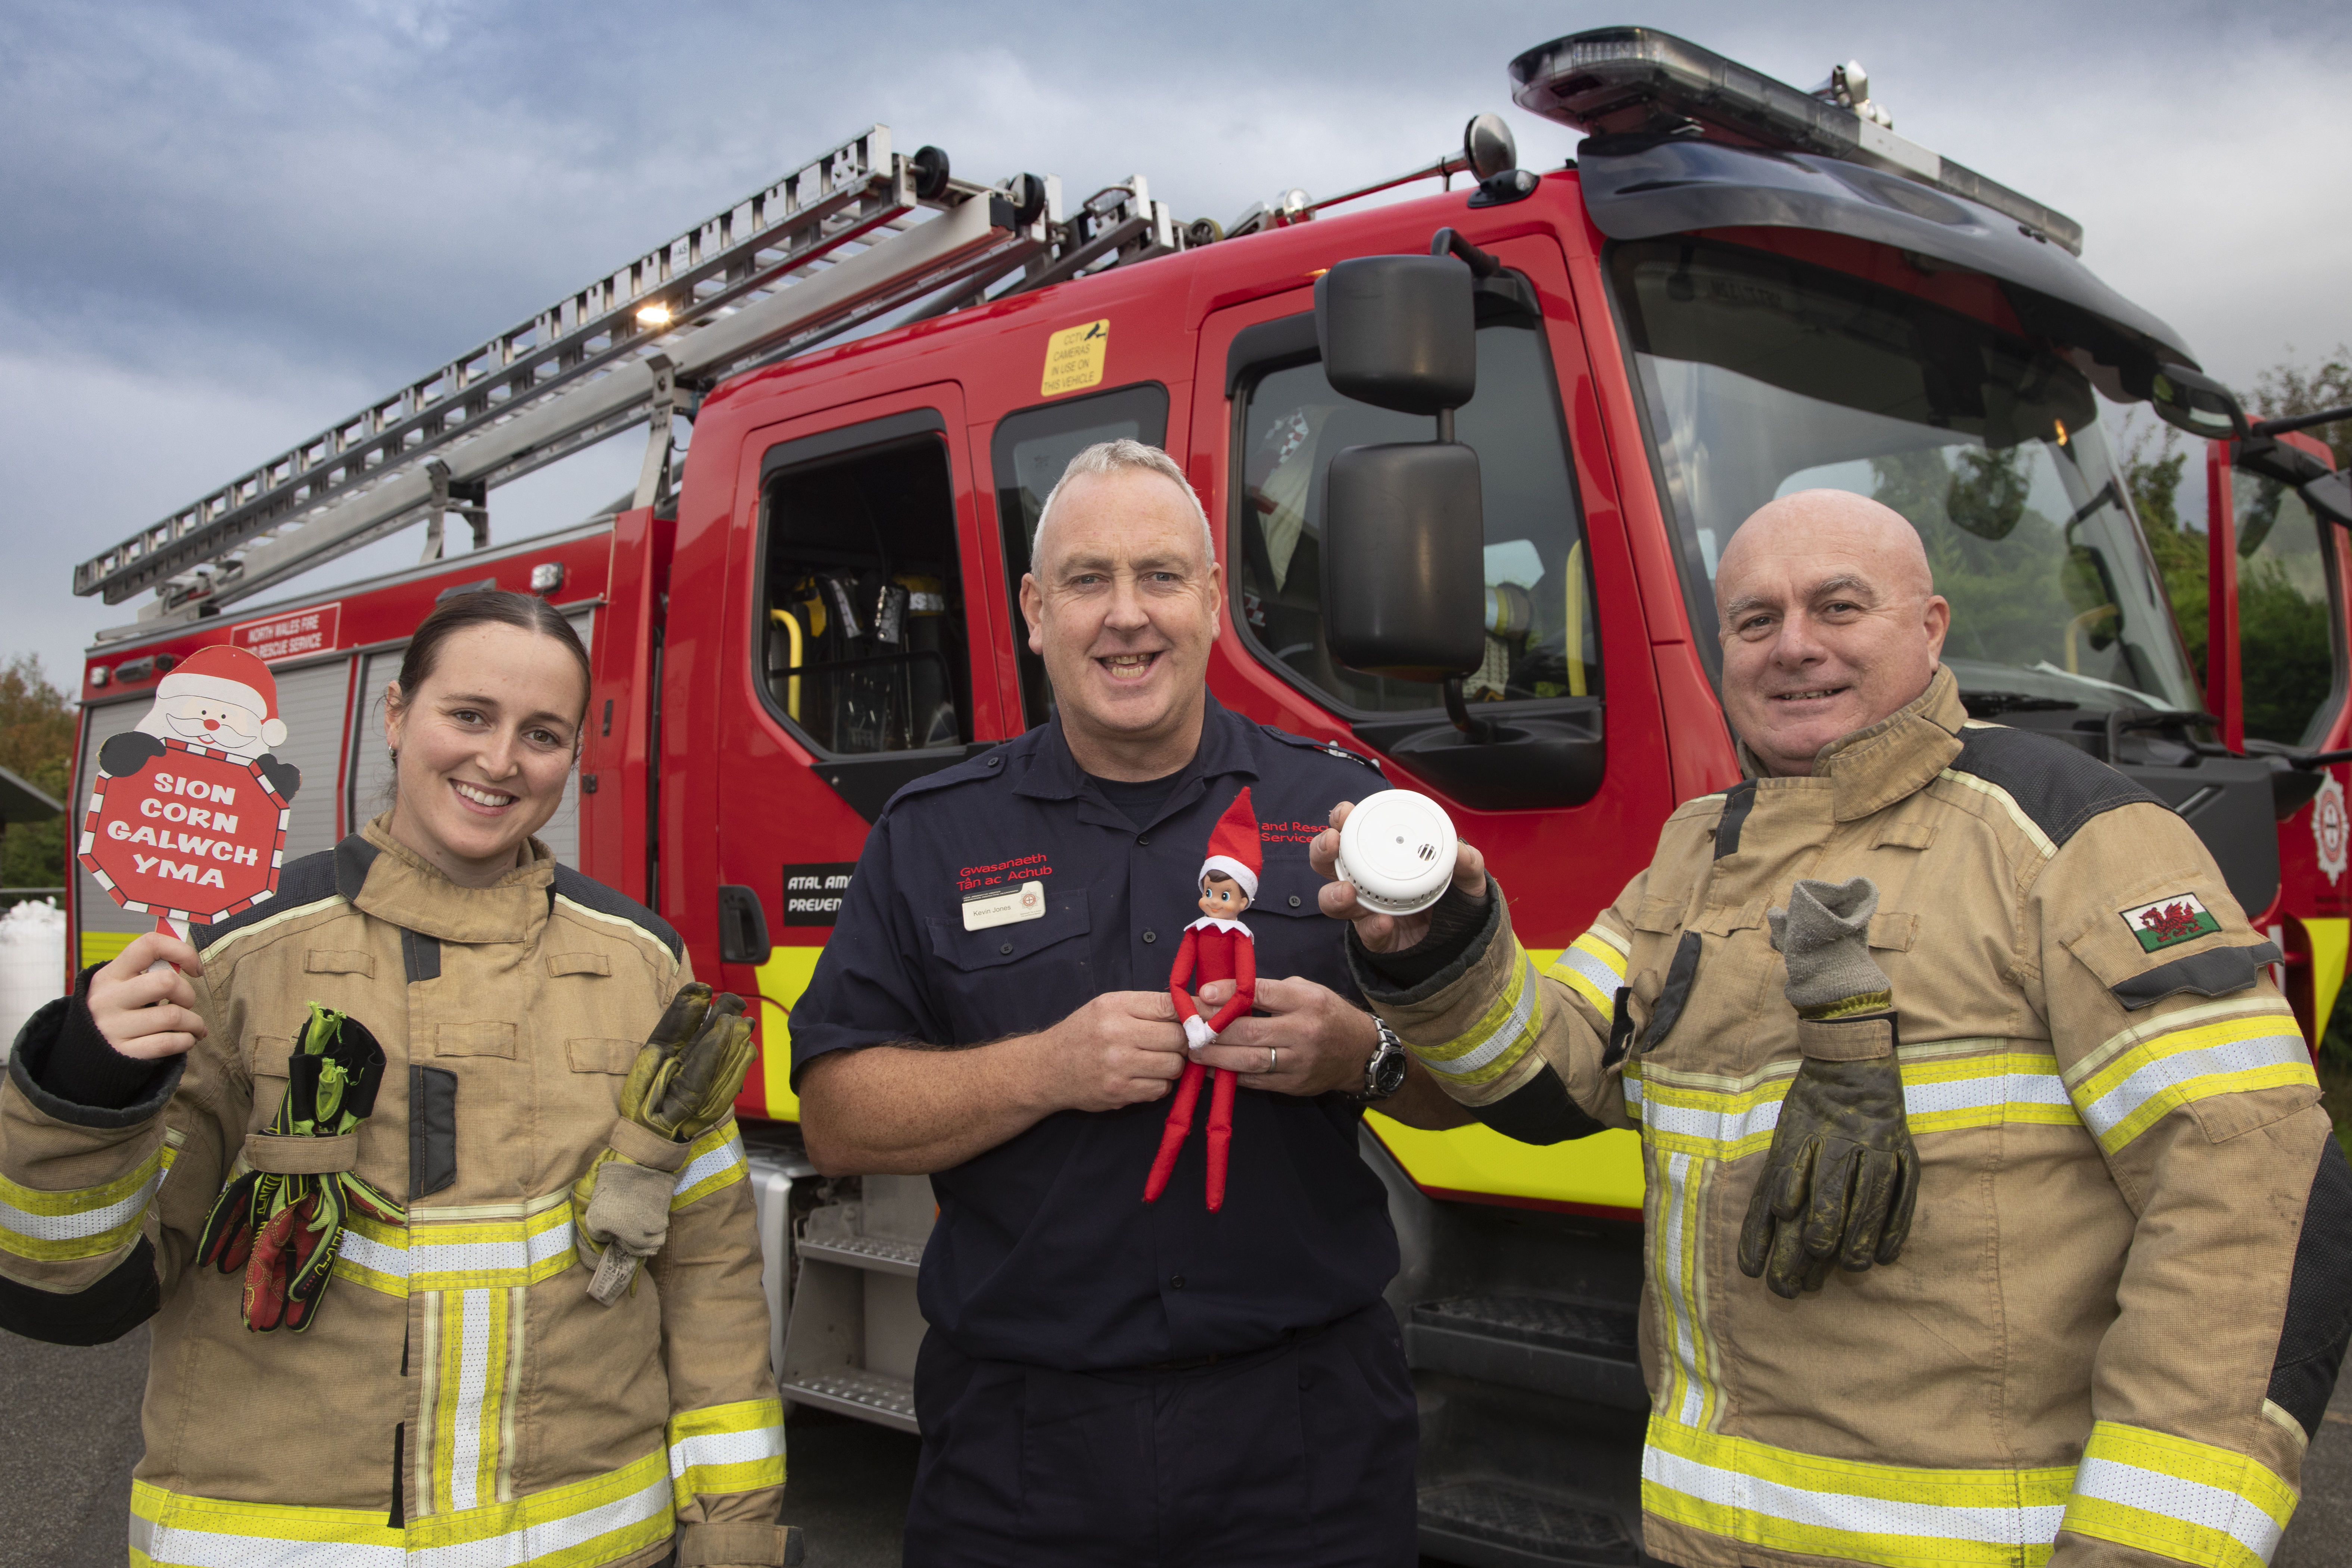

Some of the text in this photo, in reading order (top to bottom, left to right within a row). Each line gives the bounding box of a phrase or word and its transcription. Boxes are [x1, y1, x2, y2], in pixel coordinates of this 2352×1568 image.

[1064, 331, 1085, 345] CCTV
[1053, 343, 1091, 361] CAMERAS
[1051, 358, 1090, 376] IN USE ON
[1044, 371, 1094, 391] THIS VEHICLE
[247, 614, 320, 644] NORTH WALES FIRE
[258, 639, 288, 659] RESCUE
[288, 632, 323, 653] SERVICE
[154, 773, 236, 805] SION
[140, 798, 239, 834] CORN
[1261, 822, 1287, 831] and
[107, 820, 258, 866] GALWCH
[1261, 832, 1314, 843] Service
[133, 854, 225, 889] YMA
[960, 853, 1047, 877] Gwasanaeth
[788, 875, 853, 890] ATAL AM
[956, 865, 1053, 891] Tân ac Achub
